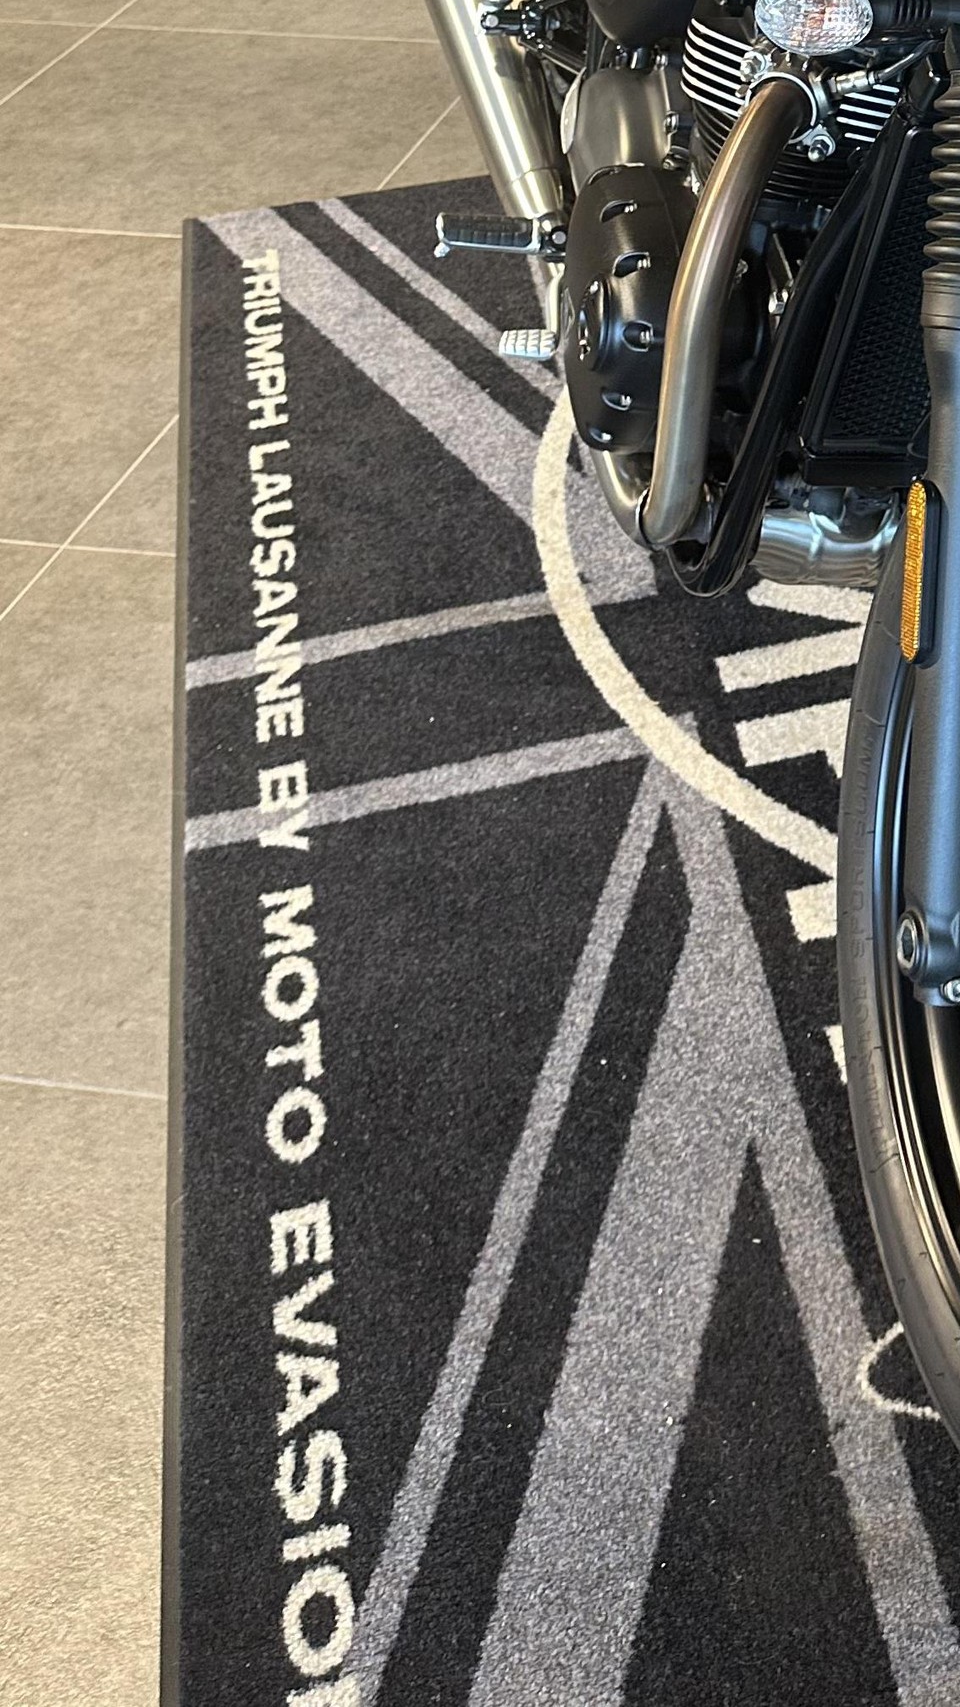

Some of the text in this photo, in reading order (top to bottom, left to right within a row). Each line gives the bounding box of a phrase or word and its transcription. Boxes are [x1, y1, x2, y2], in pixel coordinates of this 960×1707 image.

[241, 248, 288, 430] TRIUMPH
[247, 440, 304, 743] LAUSANNE
[258, 760, 309, 852] BY
[259, 884, 328, 1164] MOTO
